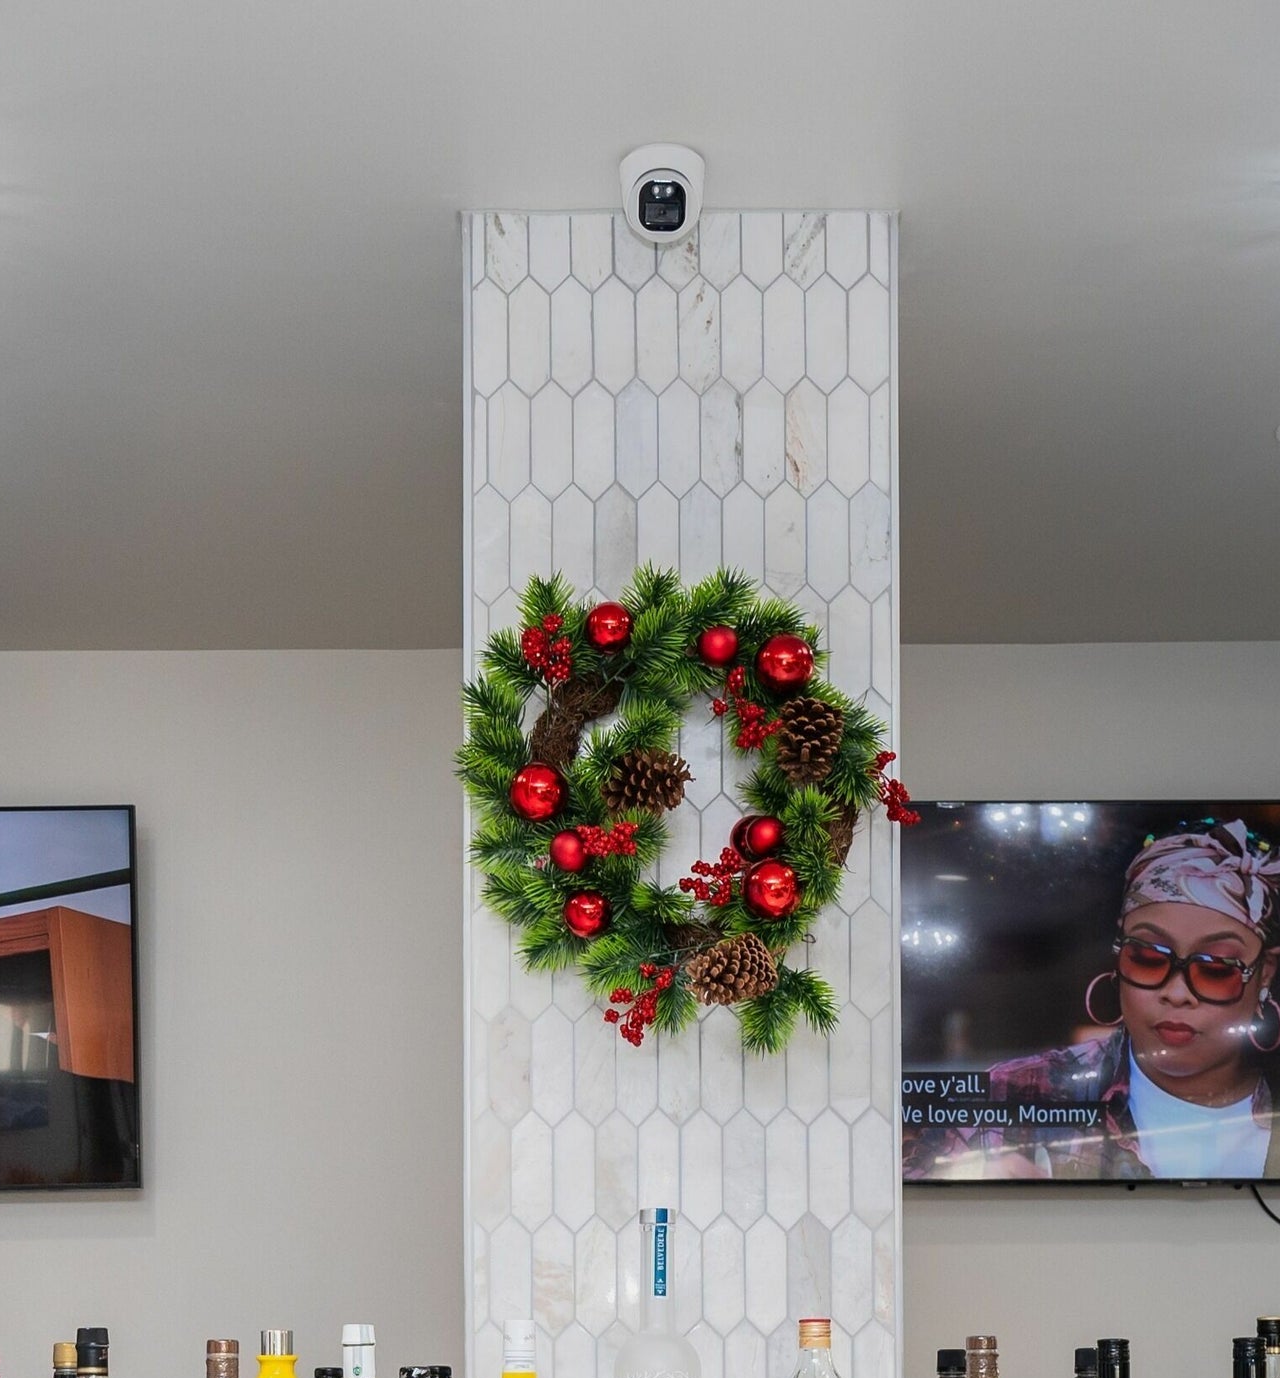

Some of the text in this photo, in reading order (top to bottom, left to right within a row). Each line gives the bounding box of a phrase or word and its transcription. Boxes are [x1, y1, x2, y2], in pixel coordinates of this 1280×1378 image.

[901, 1075, 985, 1097] ove y'all.
[928, 1104, 968, 1123] love
[972, 1109, 1013, 1126] you,
[1019, 1105, 1102, 1126] Mommy.
[657, 1228, 665, 1271] BELVEDERE
